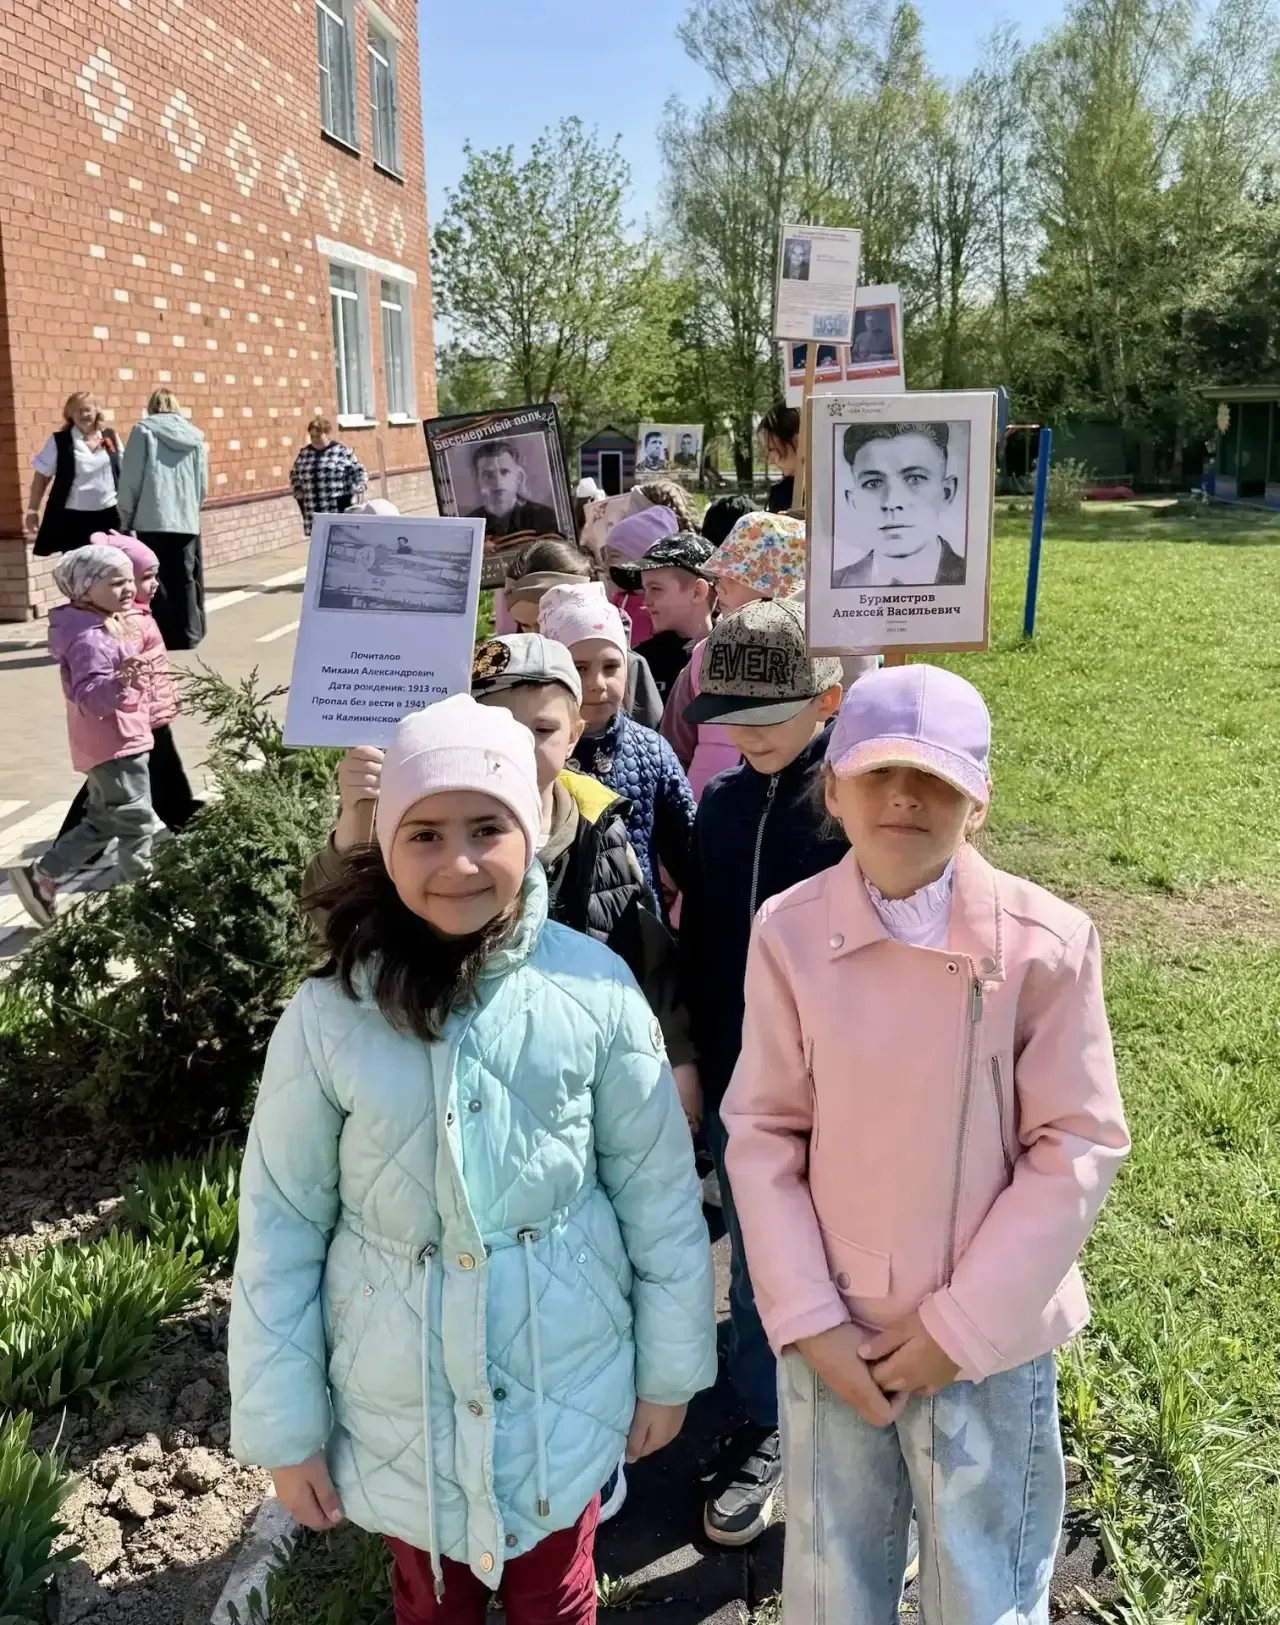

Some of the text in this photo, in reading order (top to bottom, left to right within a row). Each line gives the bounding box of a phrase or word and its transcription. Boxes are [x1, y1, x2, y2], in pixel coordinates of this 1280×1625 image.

[433, 411, 542, 451] Бессмертный полк
[859, 594, 936, 606] Бурмистров
[832, 605, 961, 618] Алексей Васильевич
[350, 651, 401, 661] Почиталов
[709, 643, 789, 684] EVER
[321, 666, 435, 678] Михаил Александрович
[328, 682, 448, 695] Дата рождения: 1913 год
[312, 696, 348, 706] Пропал
[350, 697, 366, 706] без
[369, 700, 394, 708] вести
[405, 700, 426, 709] 1941
[322, 713, 401, 723] на Калининском
